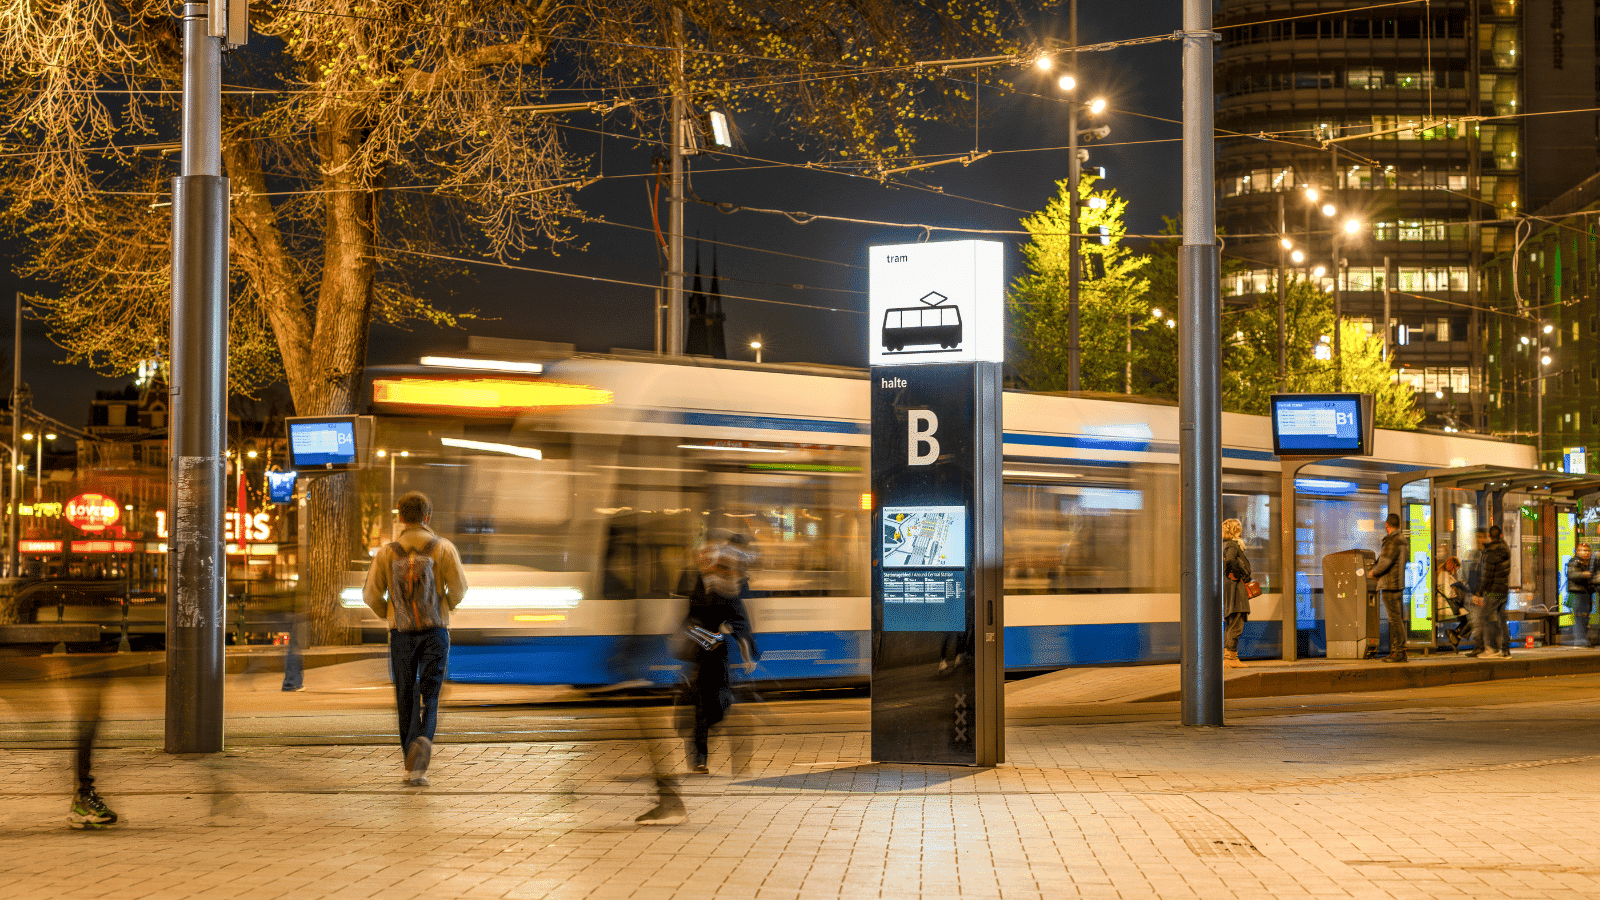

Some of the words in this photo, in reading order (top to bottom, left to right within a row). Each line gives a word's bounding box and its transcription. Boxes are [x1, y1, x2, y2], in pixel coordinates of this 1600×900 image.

[886, 254, 908, 263] tram
[881, 376, 907, 388] halte
[1336, 412, 1354, 425] B1
[337, 432, 353, 445] B4
[908, 409, 940, 466] B
[70, 503, 116, 518] LOVERS
